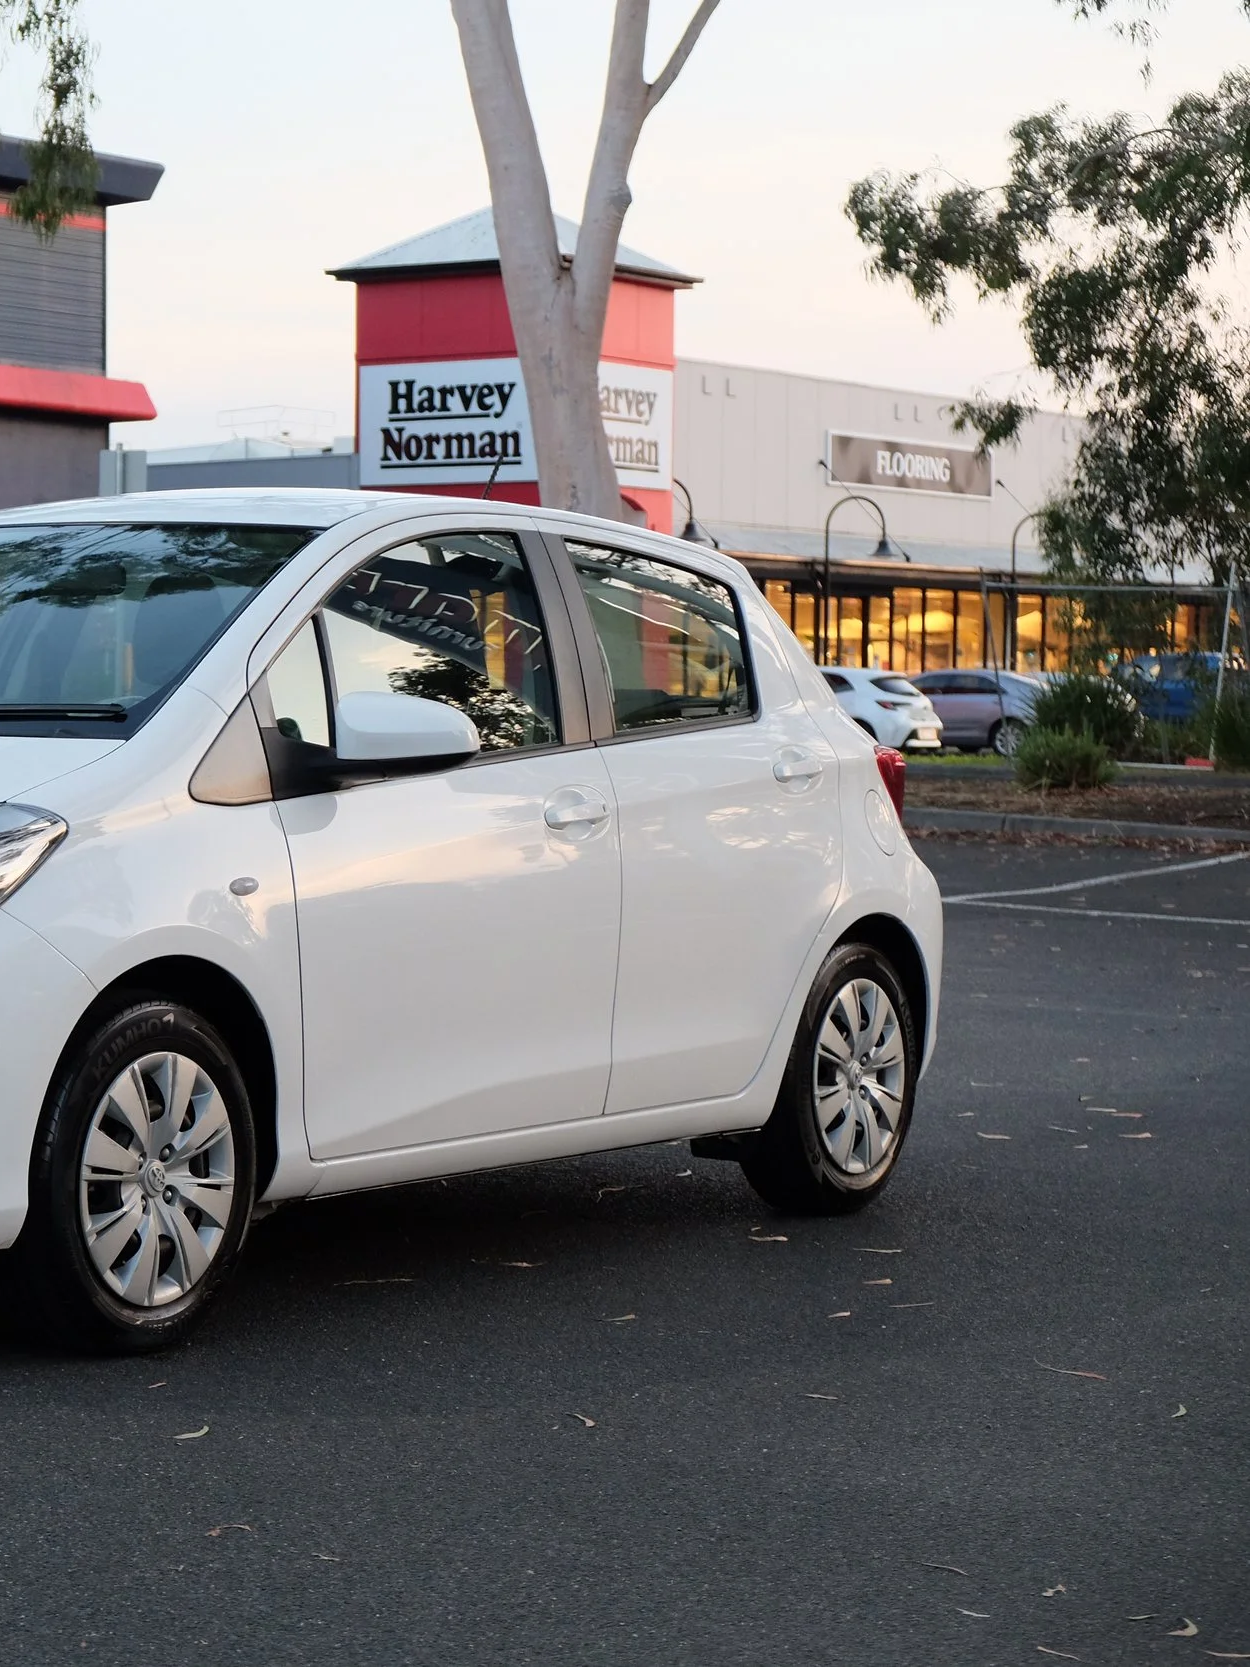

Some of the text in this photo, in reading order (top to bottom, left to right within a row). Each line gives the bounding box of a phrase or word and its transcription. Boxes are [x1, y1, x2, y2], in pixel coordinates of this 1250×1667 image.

[387, 379, 517, 419] Harvey
[599, 385, 658, 426] arvey
[379, 426, 522, 462] Norman
[876, 450, 950, 482] FLOORING
